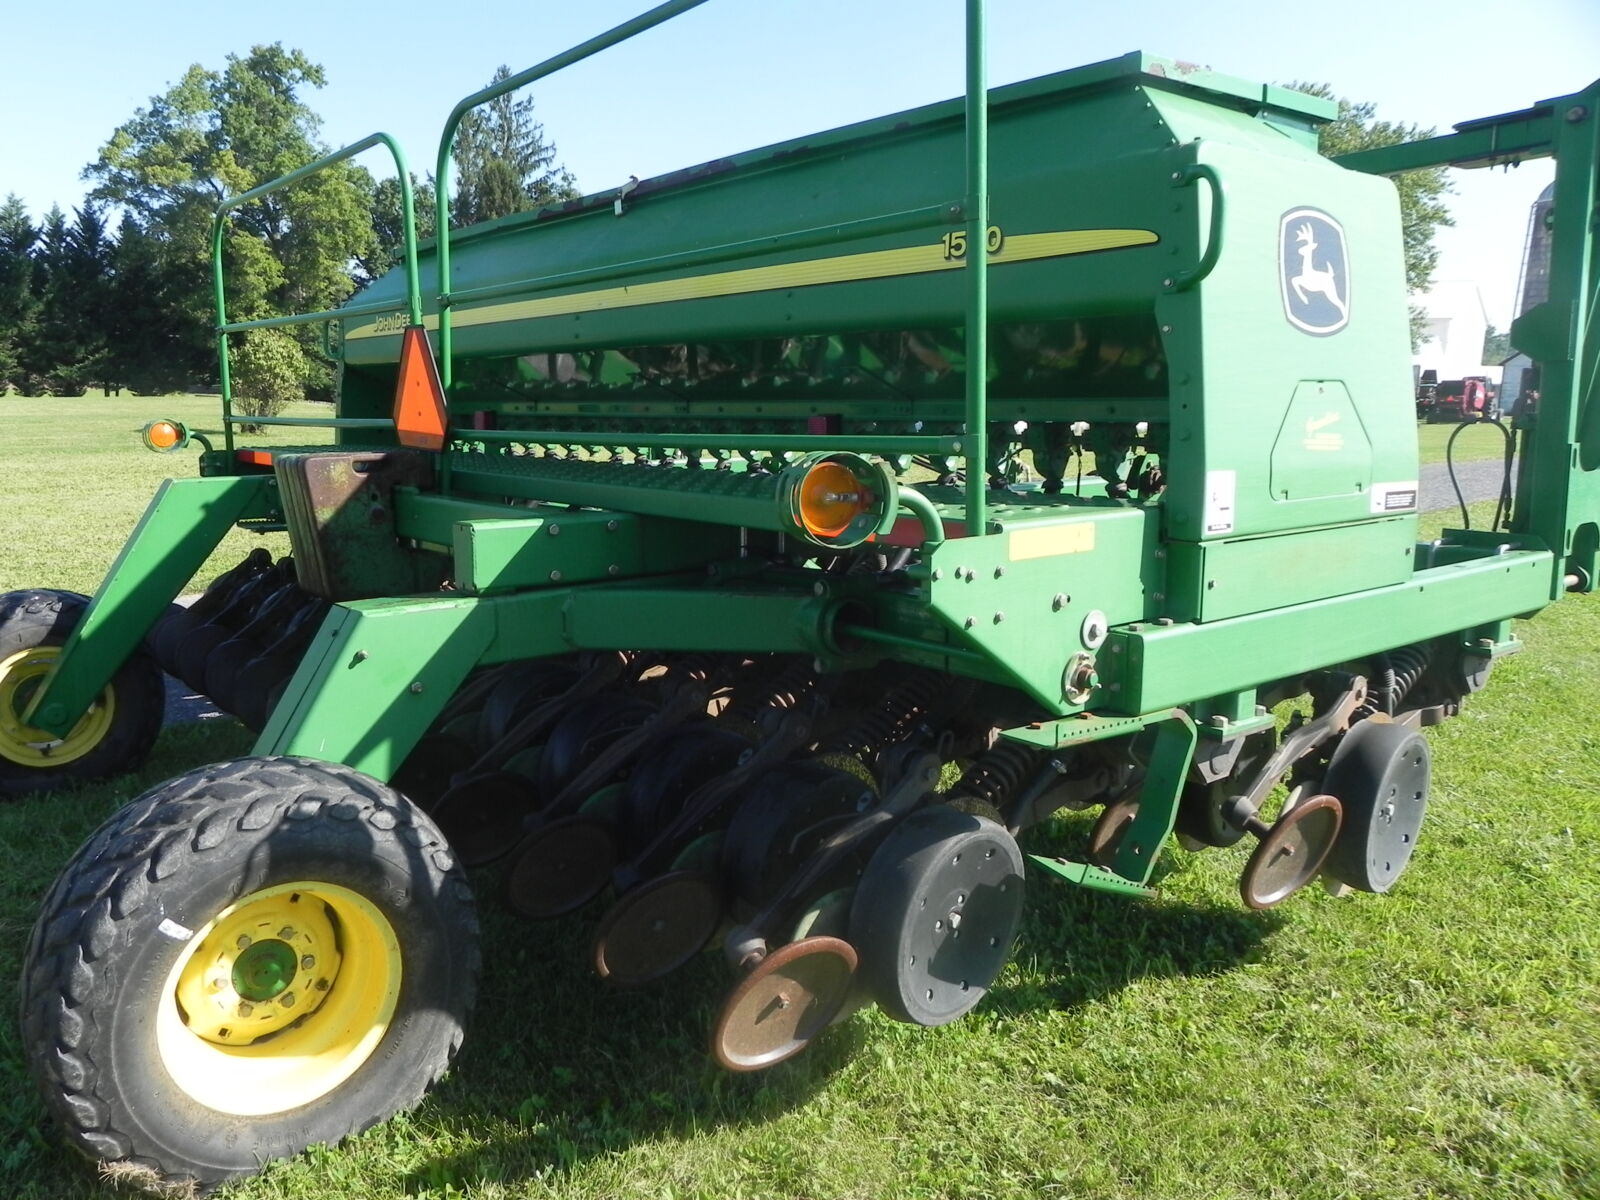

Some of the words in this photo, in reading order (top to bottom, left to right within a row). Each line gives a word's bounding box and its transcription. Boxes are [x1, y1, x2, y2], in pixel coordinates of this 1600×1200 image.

[942, 225, 1003, 259] 150
[374, 314, 396, 332] JOHN
[395, 312, 411, 329] DEE
